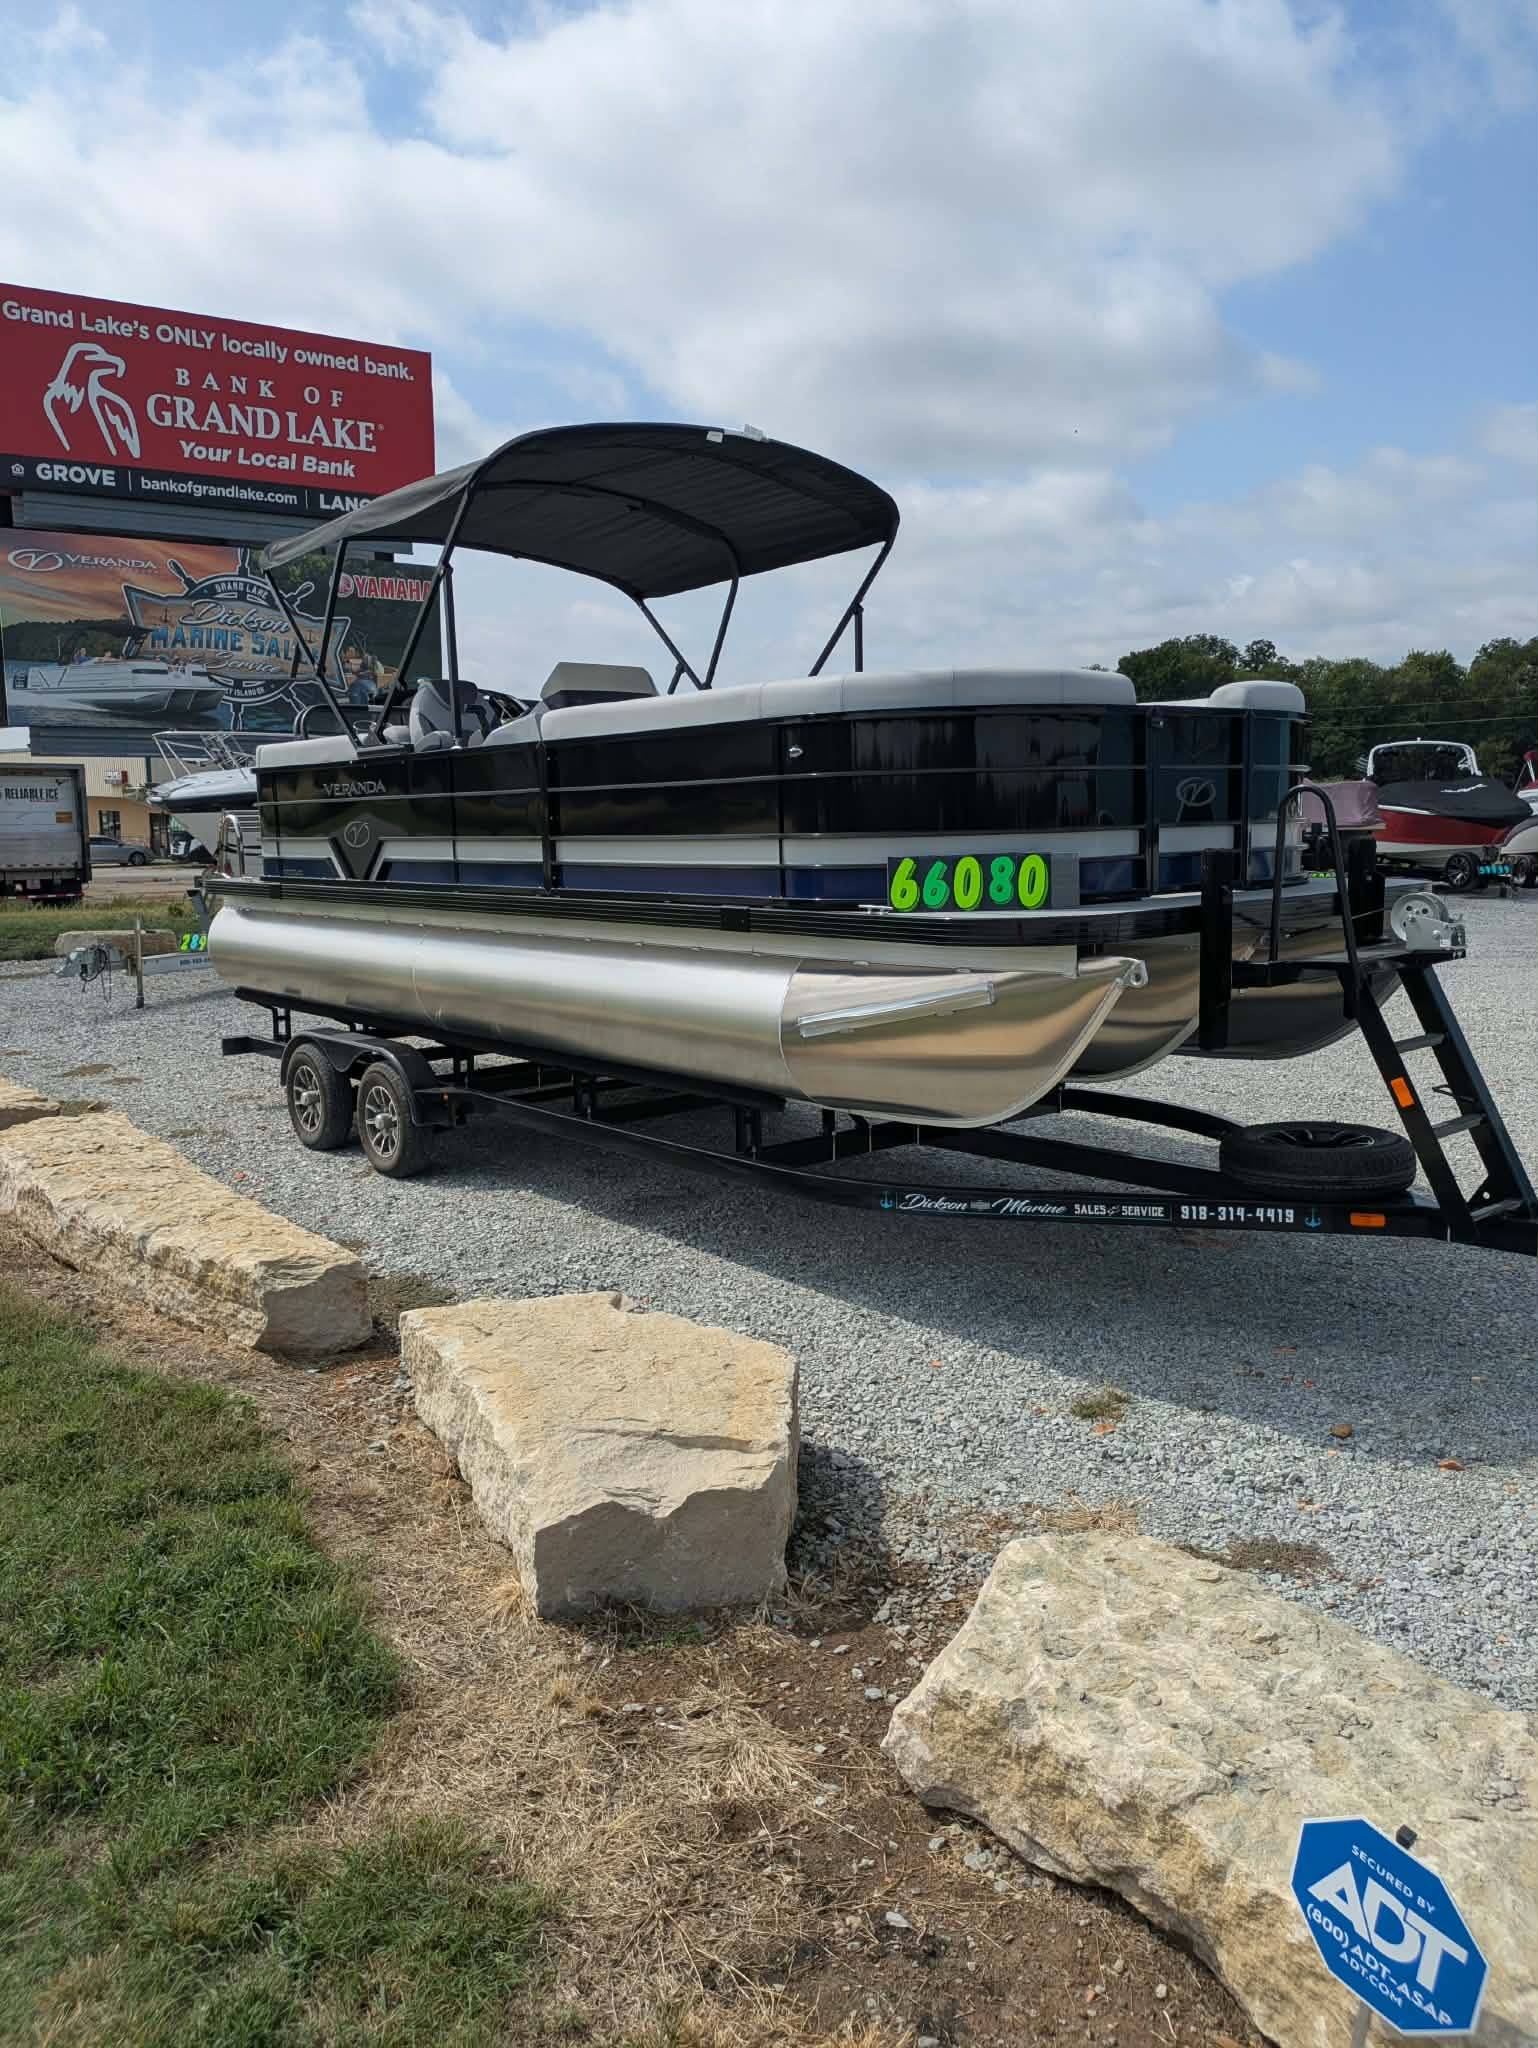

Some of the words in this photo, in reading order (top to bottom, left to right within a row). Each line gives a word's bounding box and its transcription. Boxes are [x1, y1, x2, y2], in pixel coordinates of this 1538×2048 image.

[2, 300, 74, 329] Grand
[80, 312, 150, 341] Lake's
[156, 324, 216, 350] ONLY
[222, 333, 288, 364] locally
[293, 348, 359, 373] owned
[365, 356, 415, 382] bank.
[175, 367, 276, 399] BANK
[303, 386, 343, 408] OF
[35, 462, 116, 487] GROVE
[180, 440, 231, 463] Your
[238, 447, 297, 471] Local
[303, 455, 355, 477] Bank
[140, 475, 298, 506] bankofgrandlake.com
[64, 553, 158, 569] VERANDA
[179, 599, 290, 634] Dickson
[151, 624, 244, 651] MARINE
[322, 780, 386, 797] VERANDA
[890, 854, 1048, 912] 66080
[899, 1193, 968, 1211] Dickson
[992, 1197, 1067, 1215] Marine
[1074, 1203, 1106, 1216] SALES
[1121, 1206, 1165, 1218] SERVICE
[1180, 1204, 1295, 1223] 918-314-4419
[1351, 1844, 1414, 1899] SECURED
[1416, 1895, 1436, 1914] BY
[1306, 1903, 1350, 1949] (800)
[1307, 1860, 1469, 1993] ADT
[1339, 1951, 1404, 2009] ADT.COM
